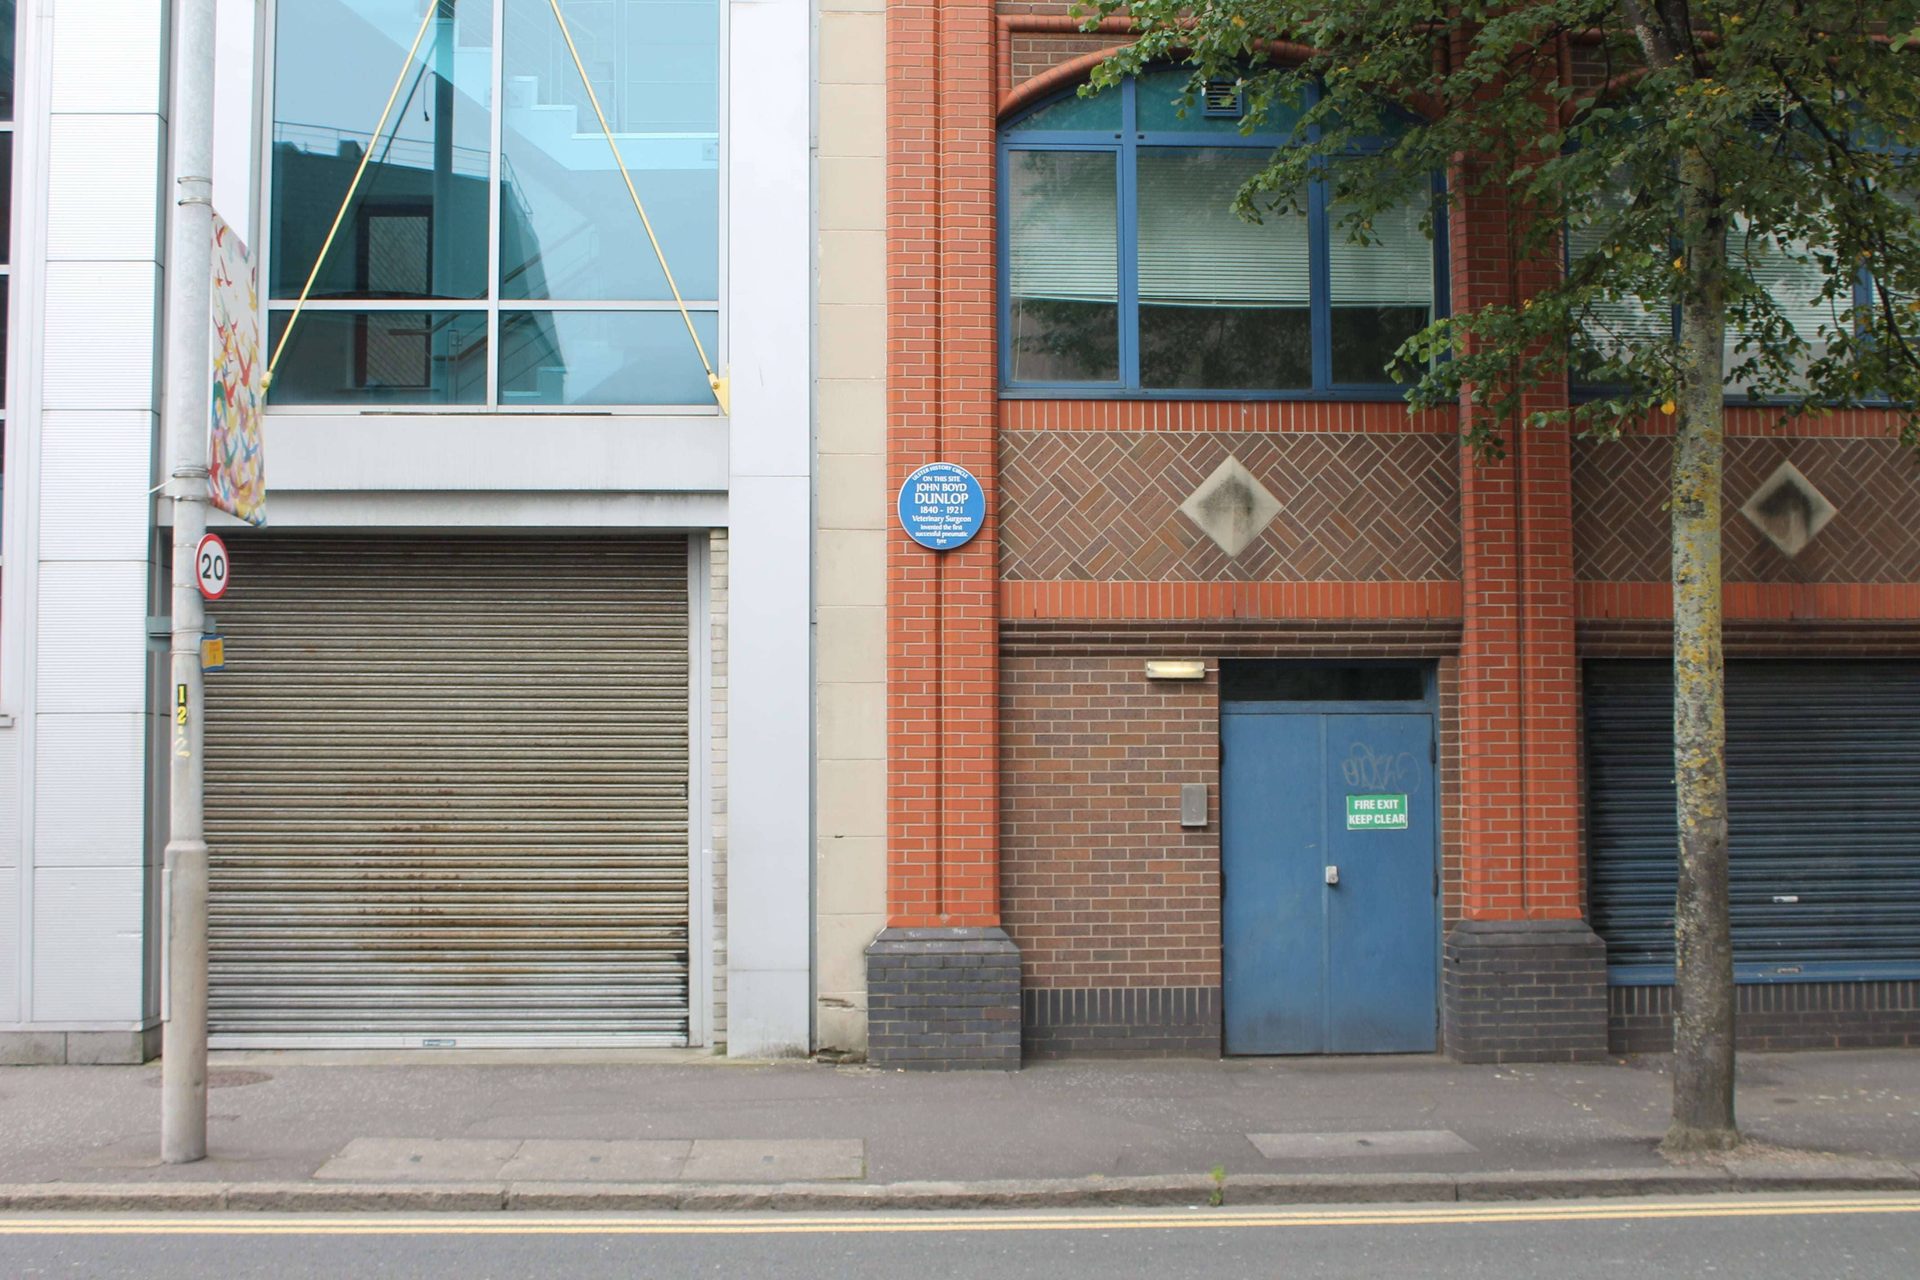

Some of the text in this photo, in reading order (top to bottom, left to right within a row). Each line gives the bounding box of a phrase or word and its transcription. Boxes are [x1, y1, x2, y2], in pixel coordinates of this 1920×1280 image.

[952, 467, 969, 479] CIRCLE
[916, 483, 967, 492] JOHN BOYD
[915, 493, 969, 504] DUNLOP
[920, 506, 938, 514] 1840
[946, 506, 963, 514] 1921
[912, 515, 972, 524] Veterinary Surgeon
[202, 554, 225, 580] 20
[1354, 799, 1399, 809] FIRE EXIT
[1349, 813, 1405, 824] KEEP CLEAR
